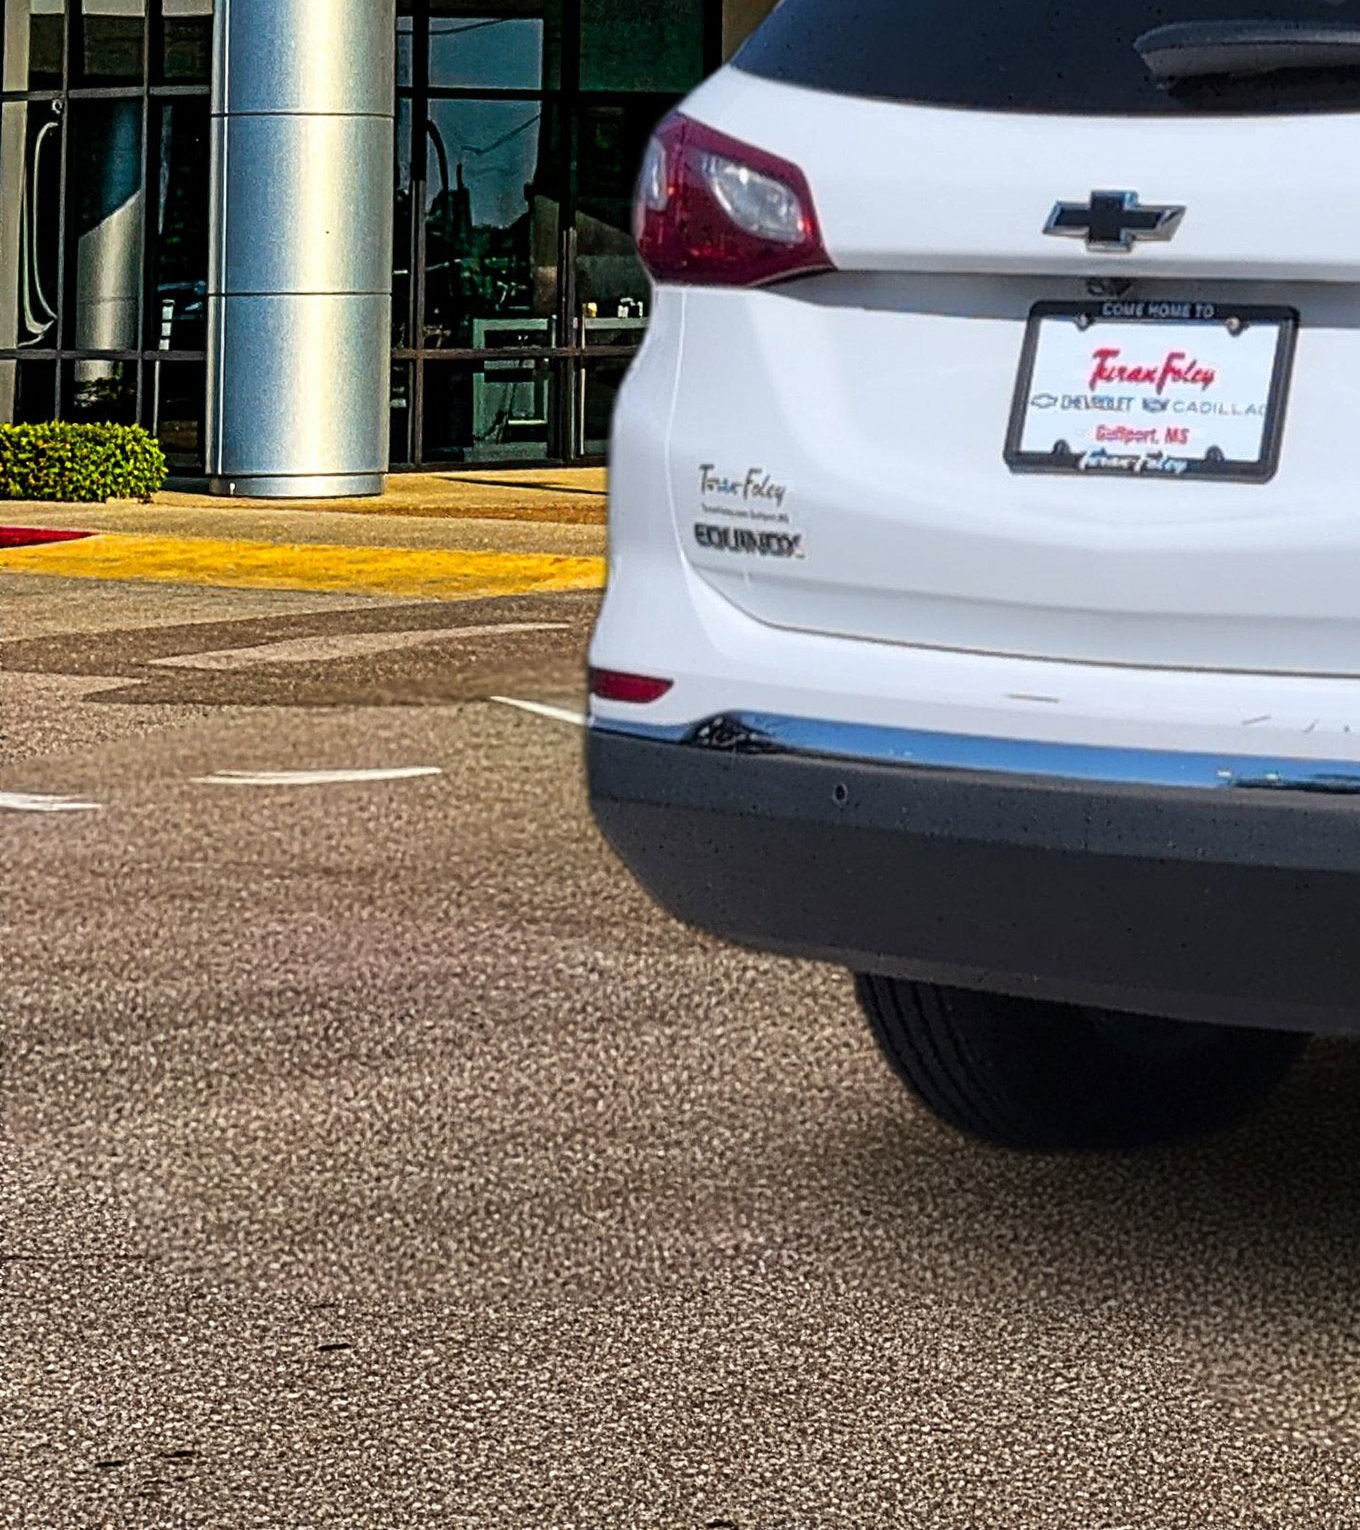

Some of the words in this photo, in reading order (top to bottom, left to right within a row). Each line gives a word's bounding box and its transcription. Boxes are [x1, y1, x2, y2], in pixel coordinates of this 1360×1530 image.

[1101, 302, 1145, 317] COME
[1147, 303, 1190, 318] HOME
[1194, 304, 1216, 318] TO
[1164, 426, 1190, 445] MS
